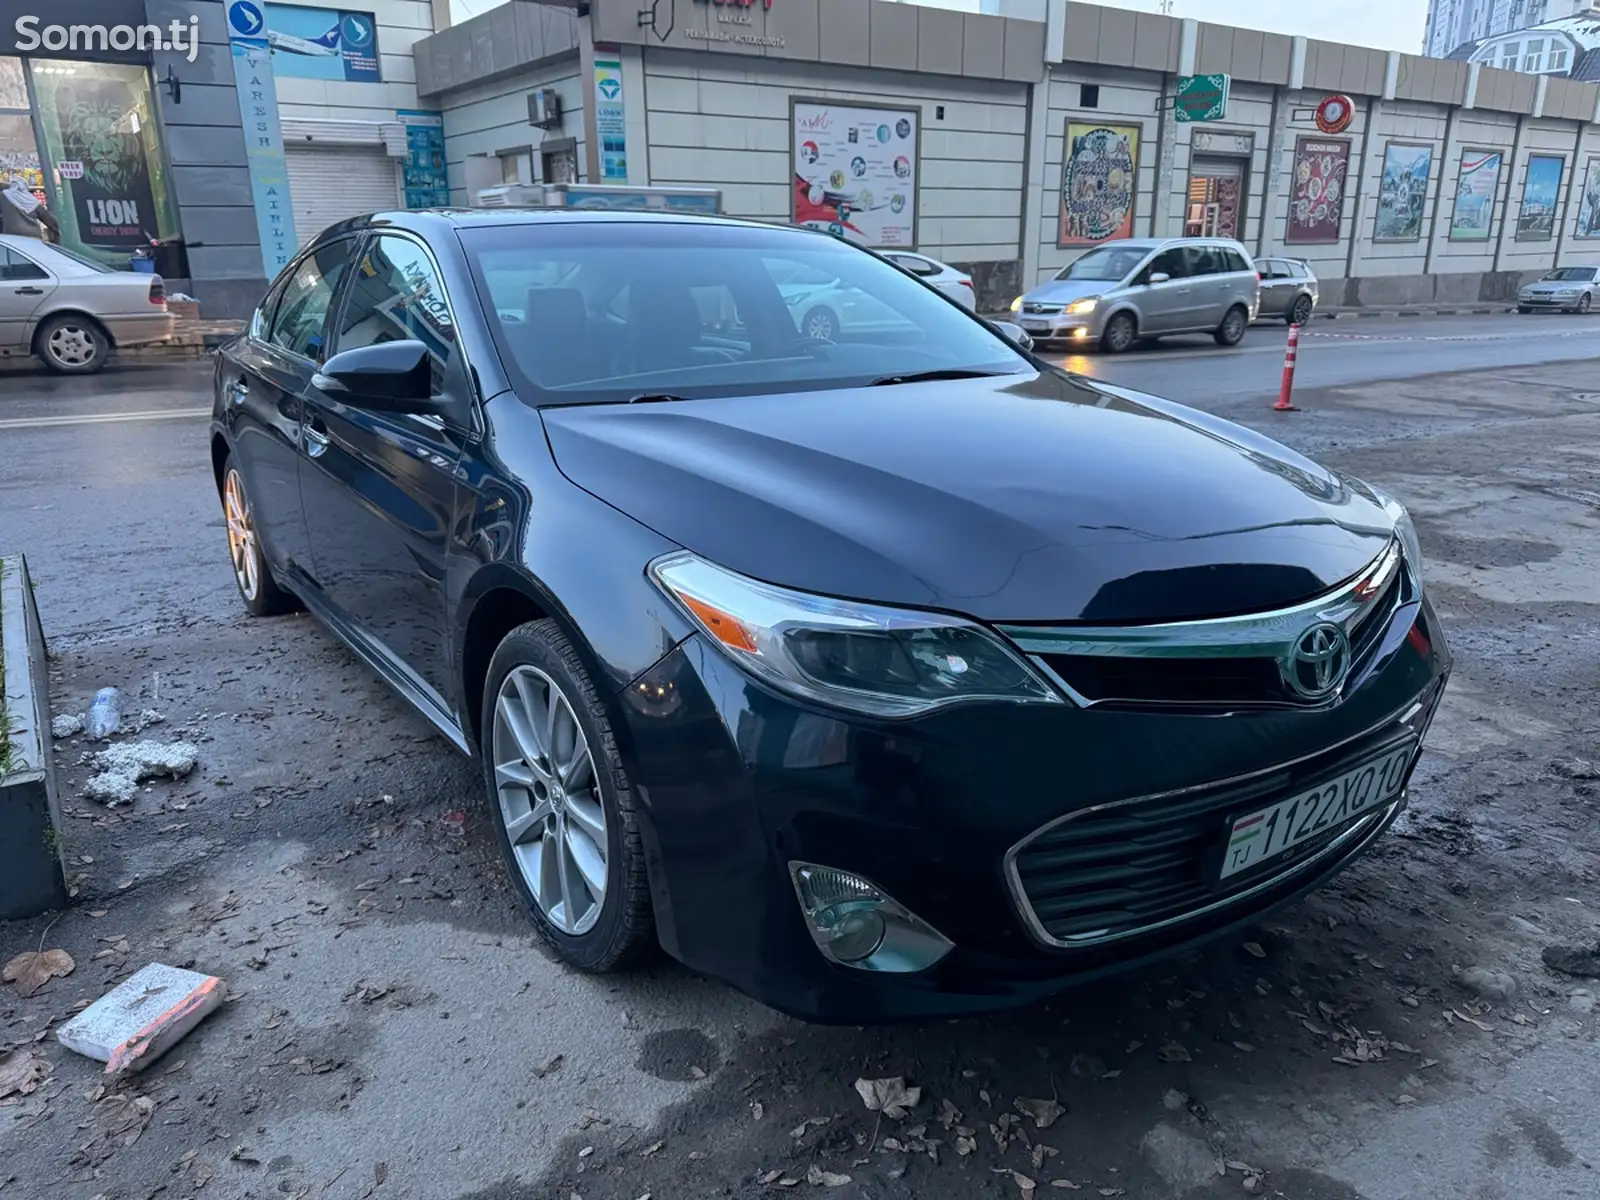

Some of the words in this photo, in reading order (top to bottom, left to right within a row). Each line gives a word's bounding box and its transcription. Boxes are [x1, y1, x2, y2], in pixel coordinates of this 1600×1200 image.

[247, 59, 271, 147] VARESH
[86, 199, 140, 225] LION
[1232, 845, 1250, 869] TJ
